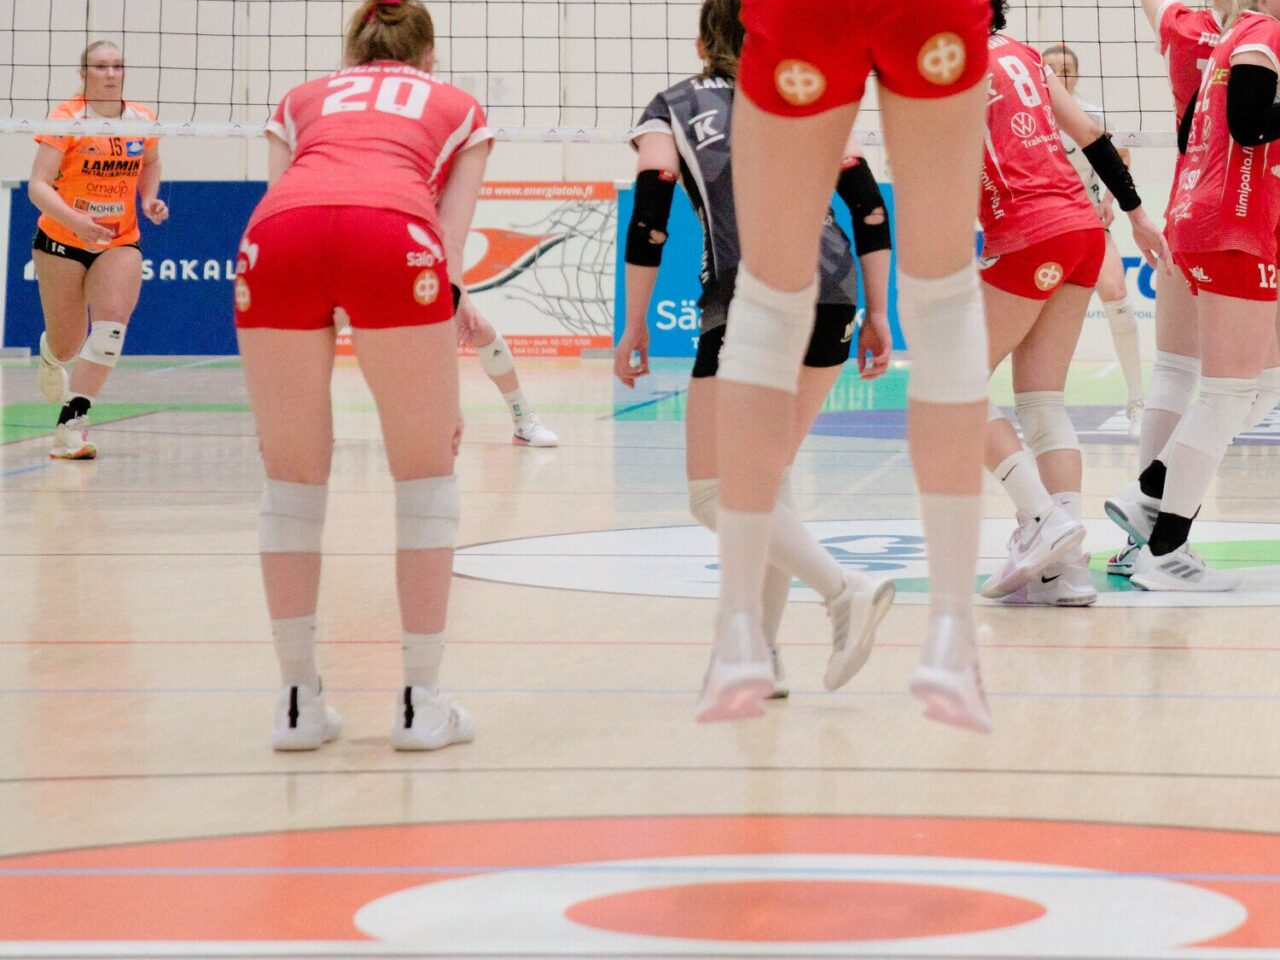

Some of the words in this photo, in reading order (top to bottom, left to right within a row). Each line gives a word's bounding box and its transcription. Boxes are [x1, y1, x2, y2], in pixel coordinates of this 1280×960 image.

[321, 76, 432, 120] 20
[998, 55, 1041, 107] 8
[109, 137, 123, 156] 15
[1257, 263, 1278, 288] 12
